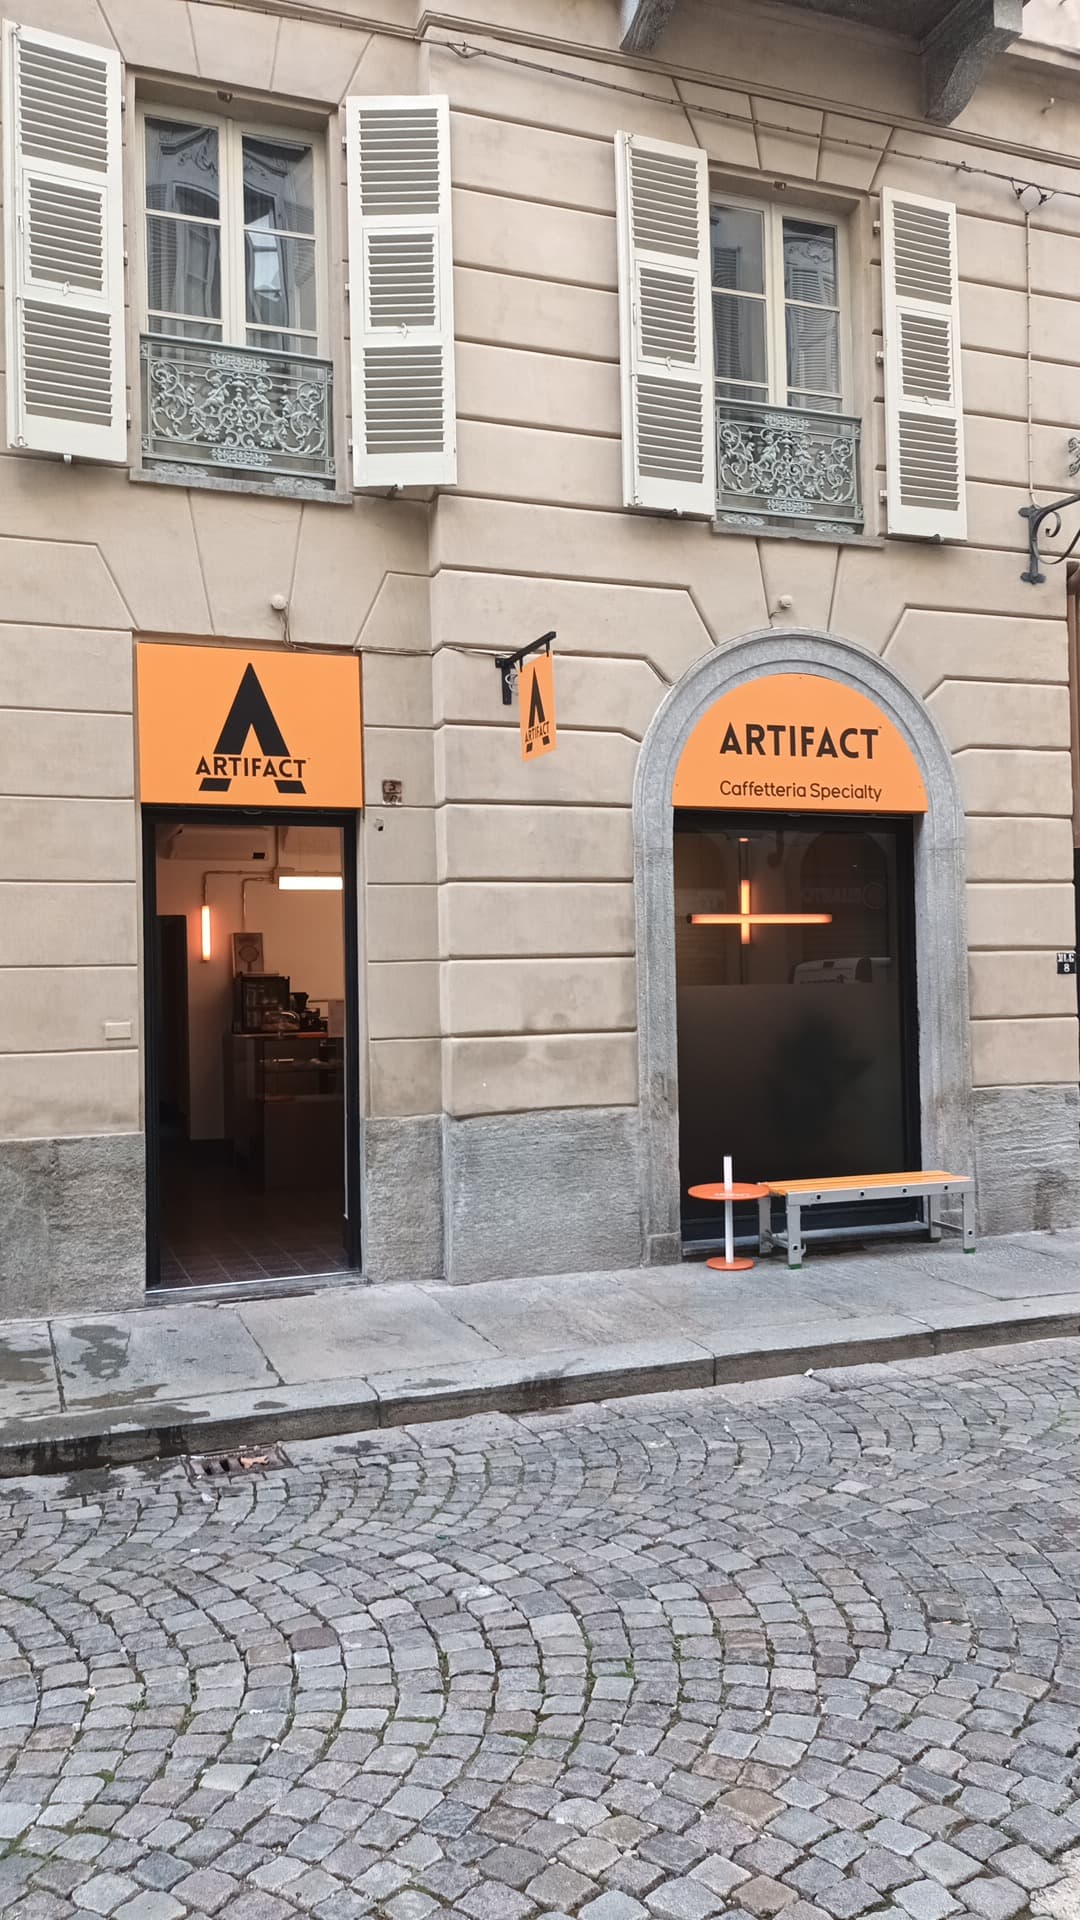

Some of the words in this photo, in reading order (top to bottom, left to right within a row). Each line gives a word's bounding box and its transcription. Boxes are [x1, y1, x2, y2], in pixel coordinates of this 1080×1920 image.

[525, 721, 550, 743] ARTIFACT
[719, 722, 879, 760] ARTIFACT
[195, 755, 307, 778] ARTIFACT
[719, 780, 807, 798] Caffetteria
[809, 783, 883, 803] Specialty
[1063, 963, 1071, 973] 8
